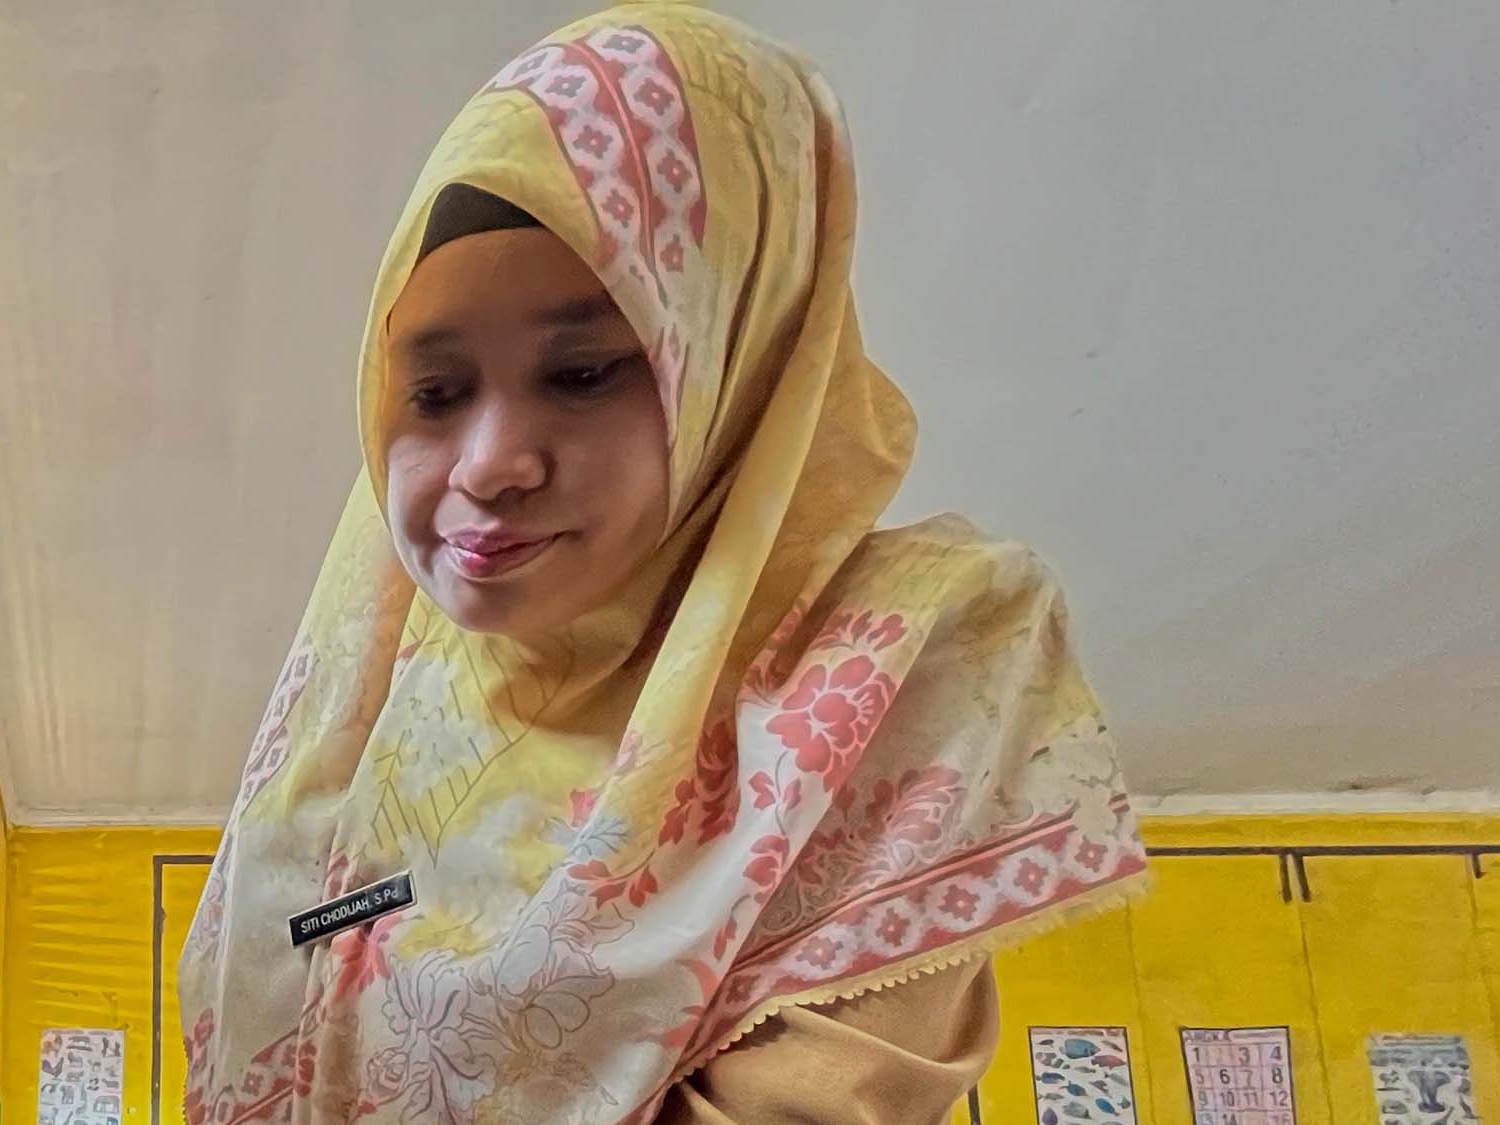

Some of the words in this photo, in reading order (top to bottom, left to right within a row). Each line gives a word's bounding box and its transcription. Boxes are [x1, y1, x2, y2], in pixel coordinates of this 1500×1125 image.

[300, 916, 320, 934] SITI
[1193, 1047, 1201, 1063] 1
[1238, 1047, 1251, 1065] 3
[1269, 1046, 1283, 1061] 4
[1219, 1068, 1231, 1085] 6
[1240, 1069, 1253, 1088] 7
[1271, 1067, 1284, 1084] 8
[1198, 1091, 1208, 1107] 9
[1220, 1091, 1236, 1107] 10
[1243, 1091, 1259, 1107] 11
[1269, 1090, 1289, 1107] 12
